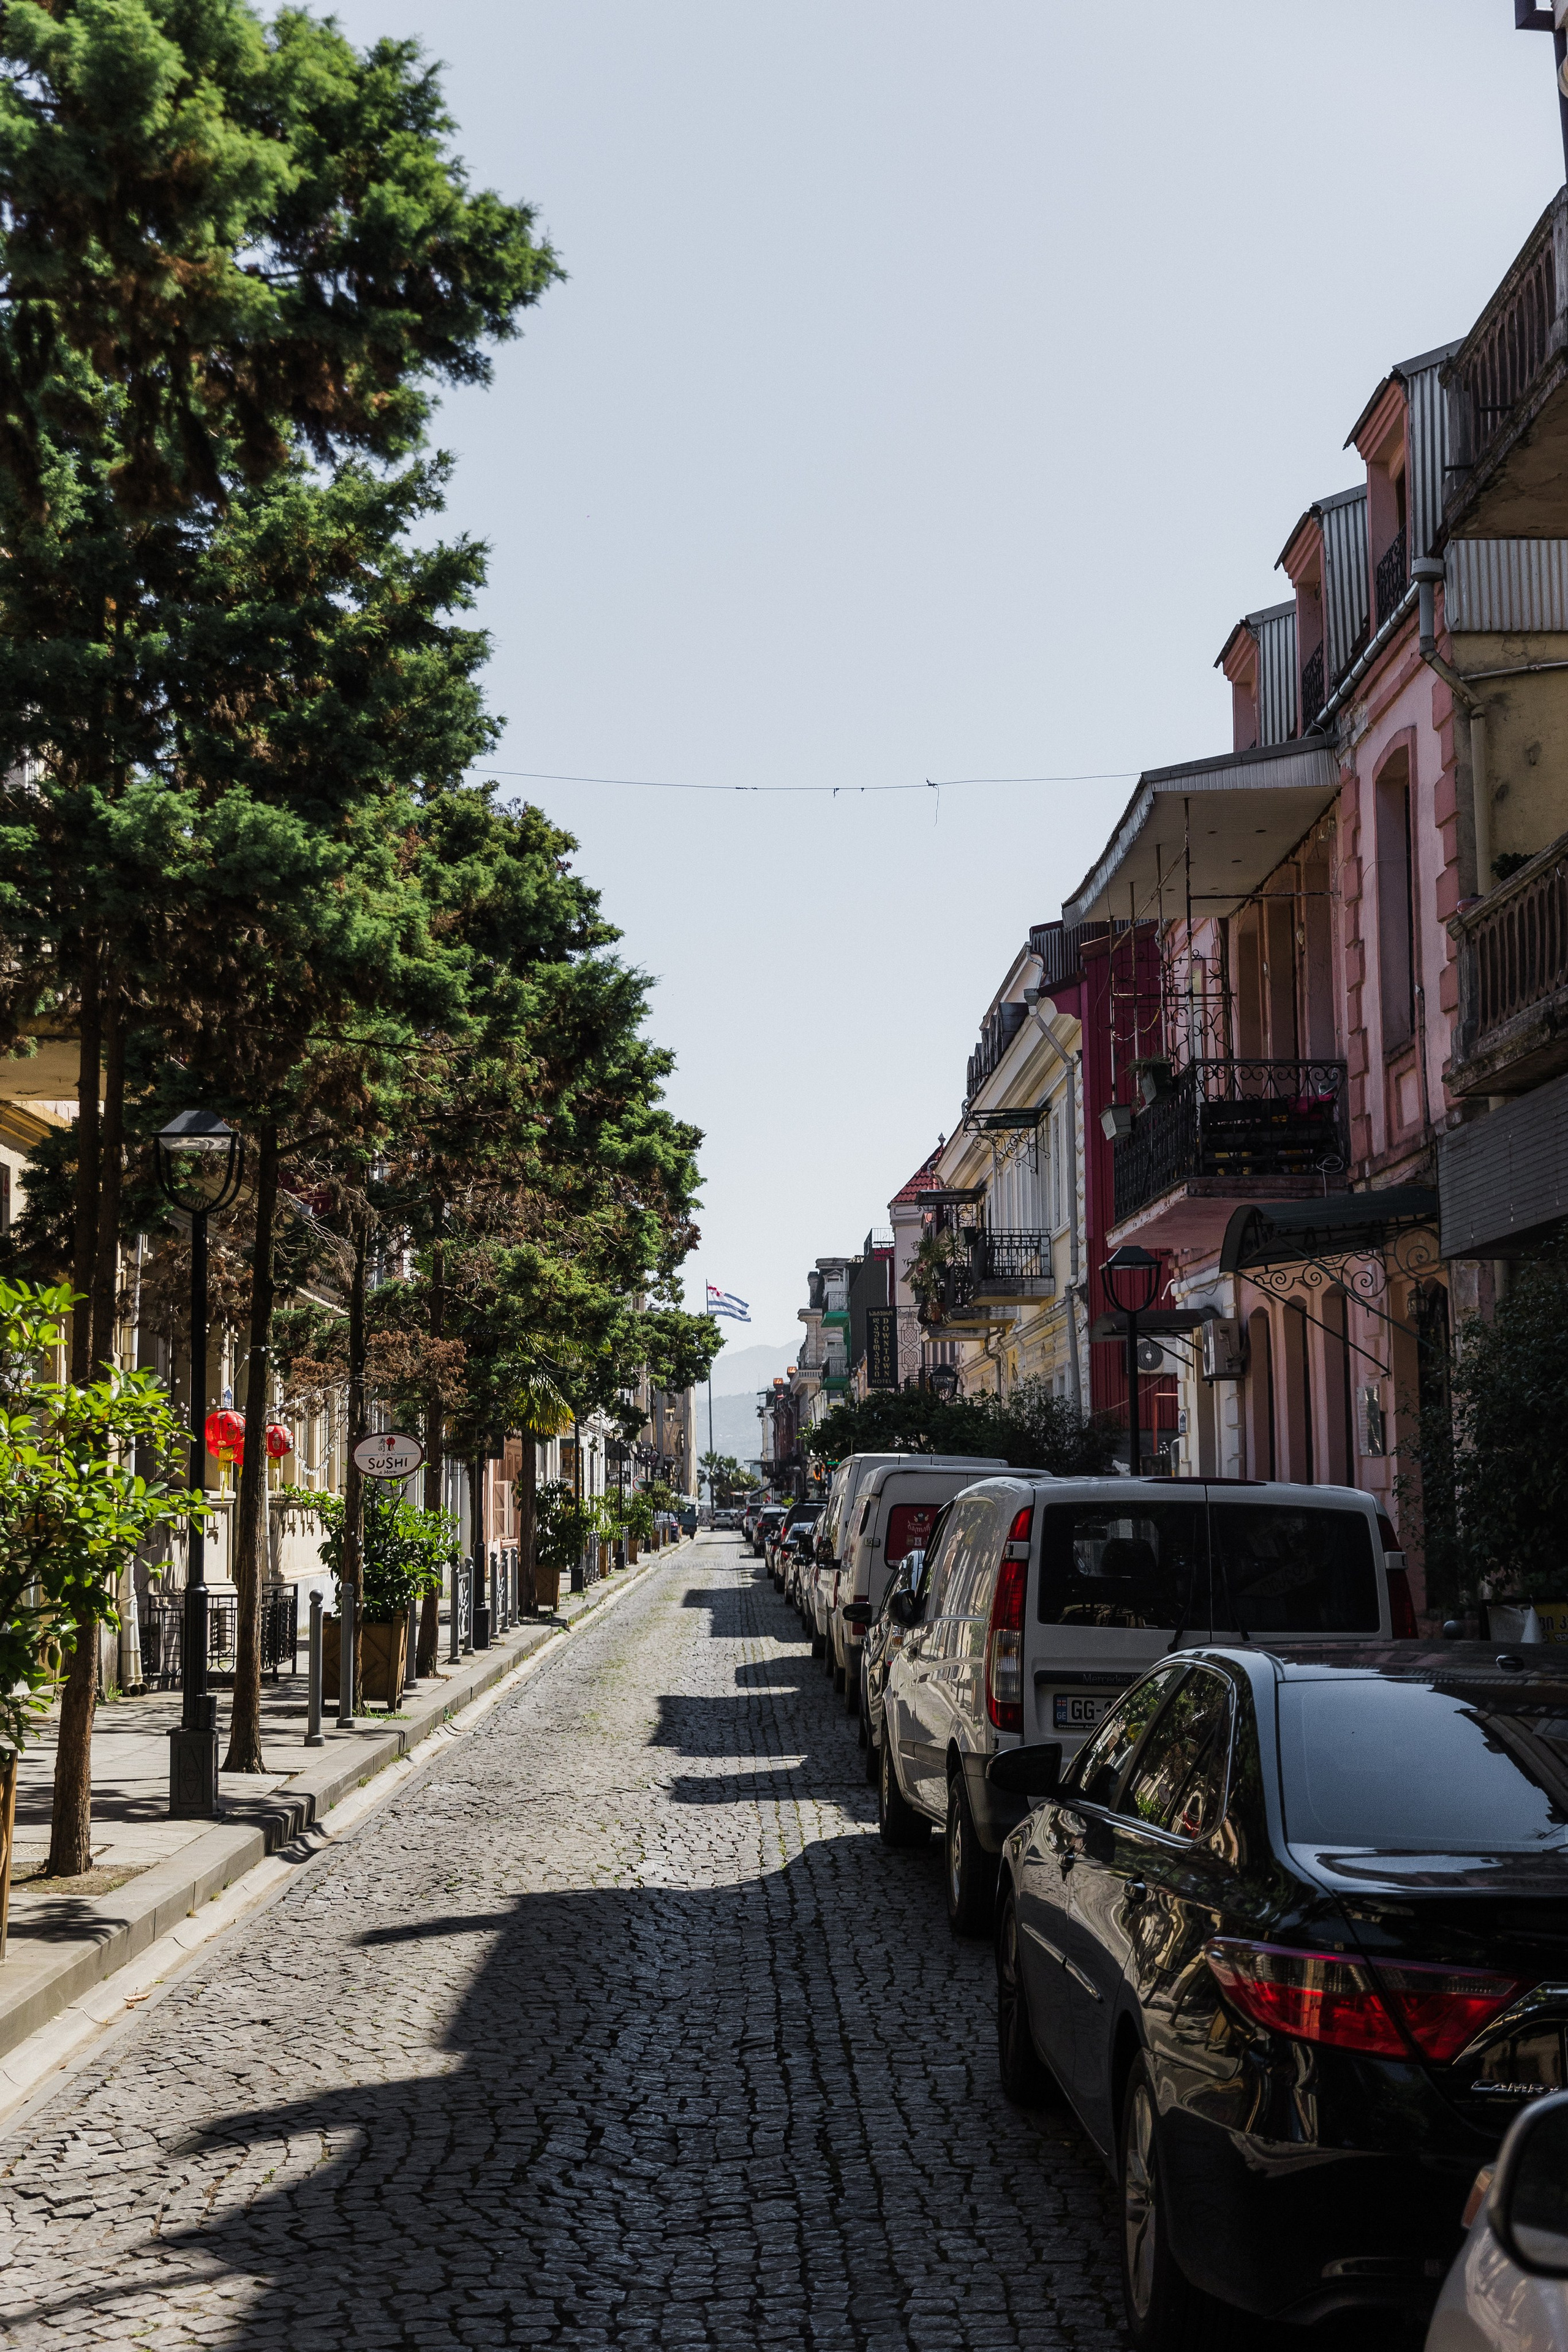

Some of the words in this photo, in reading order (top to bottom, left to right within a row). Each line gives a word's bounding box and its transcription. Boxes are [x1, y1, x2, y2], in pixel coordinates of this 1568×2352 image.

[882, 1317, 891, 1377] DOWNTOWN
[609, 1472, 625, 1481] TATTO
[1057, 1711, 1066, 1720] GE
